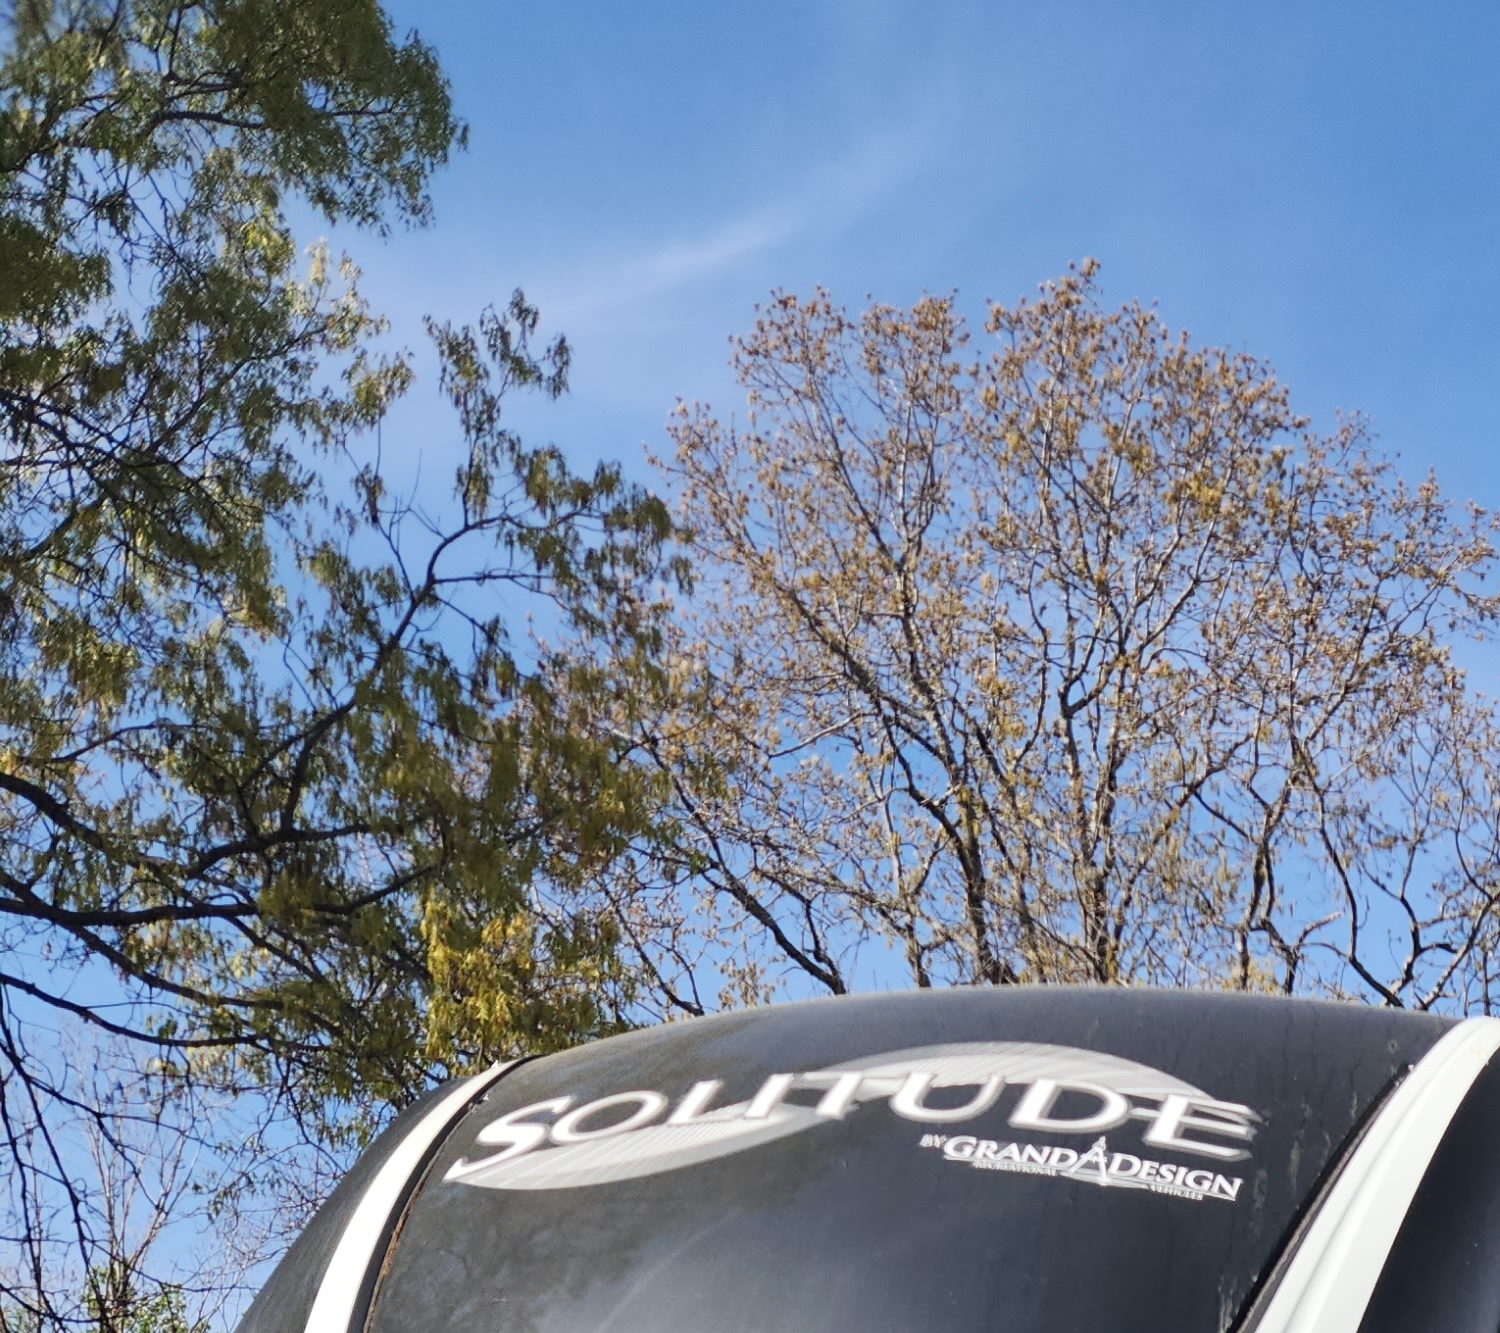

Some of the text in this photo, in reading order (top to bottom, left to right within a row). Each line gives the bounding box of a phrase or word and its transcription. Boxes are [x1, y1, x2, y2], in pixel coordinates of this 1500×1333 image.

[442, 1071, 1257, 1182] SOLITUDE
[943, 1135, 1078, 1170] GRAND
[1109, 1153, 1243, 1199] DESIGN
